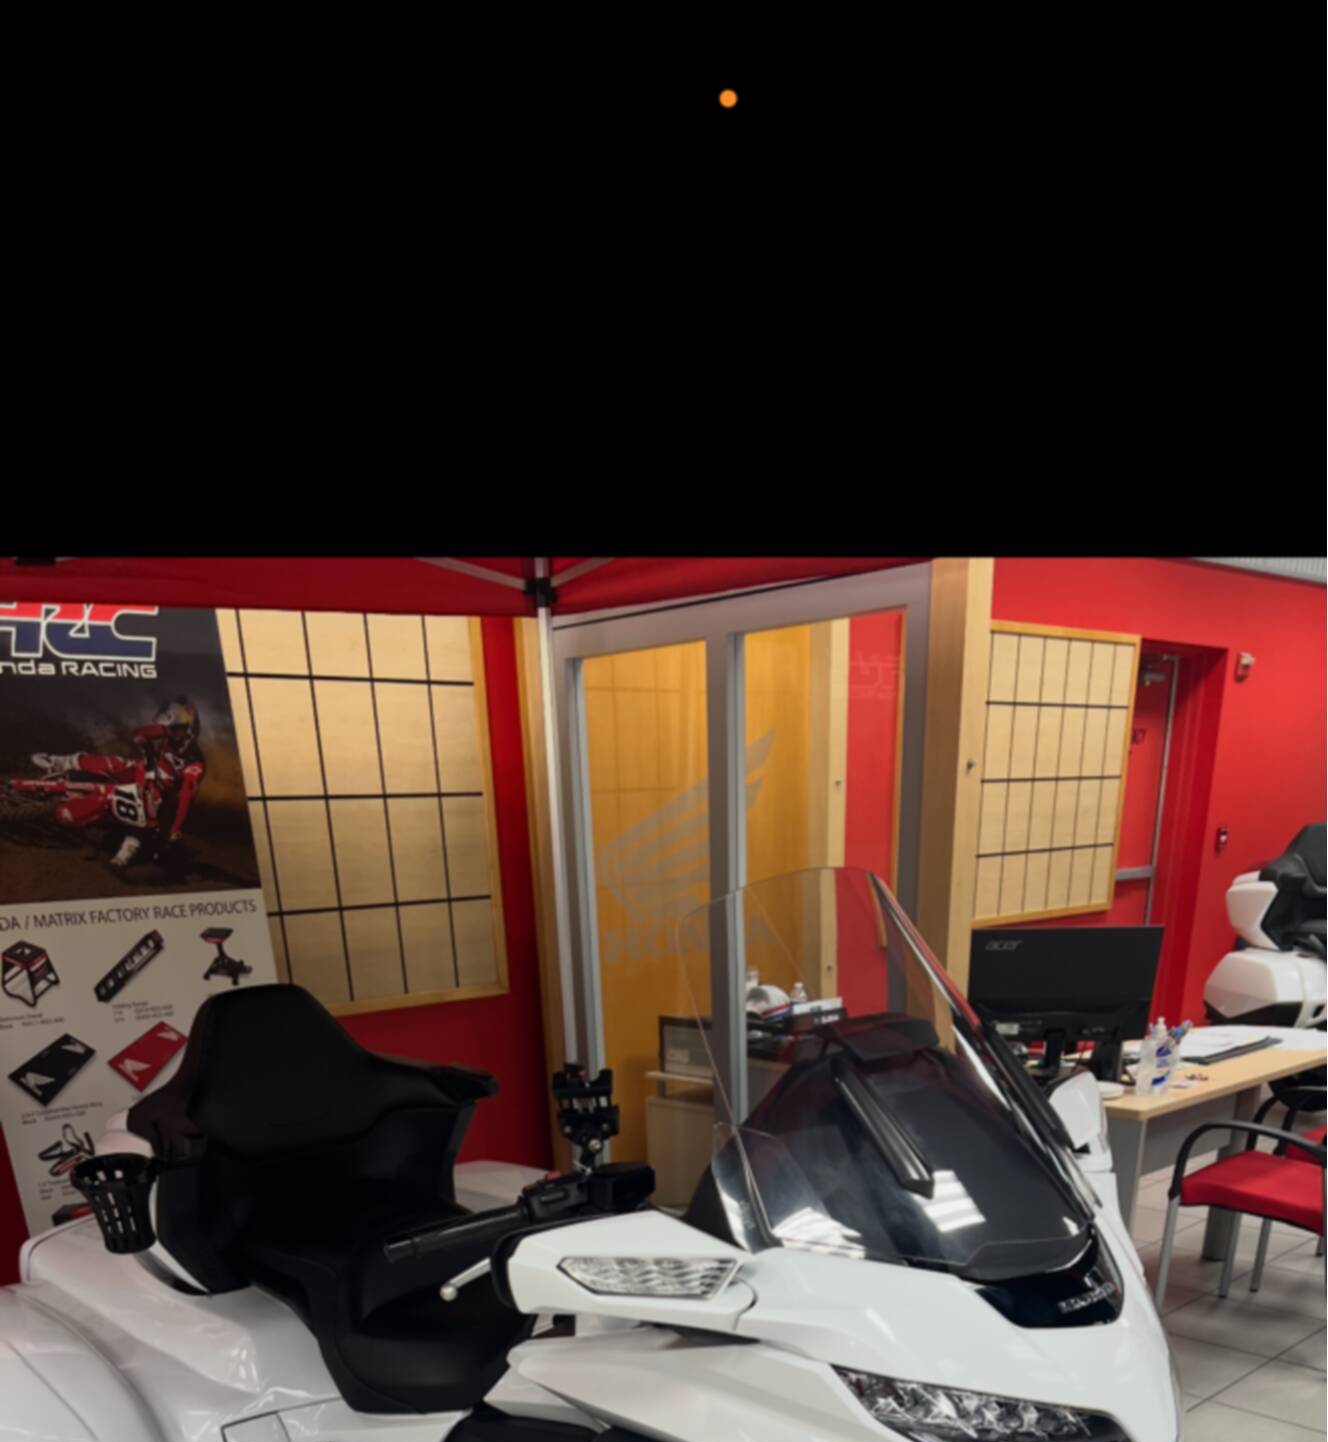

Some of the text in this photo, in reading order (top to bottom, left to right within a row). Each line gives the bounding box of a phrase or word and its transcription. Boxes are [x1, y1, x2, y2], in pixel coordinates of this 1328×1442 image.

[61, 661, 158, 679] RACING
[33, 911, 88, 928] MATRIX
[89, 906, 150, 925] FACTORY
[153, 904, 187, 920] RACE
[189, 898, 257, 917] PRODUCTS
